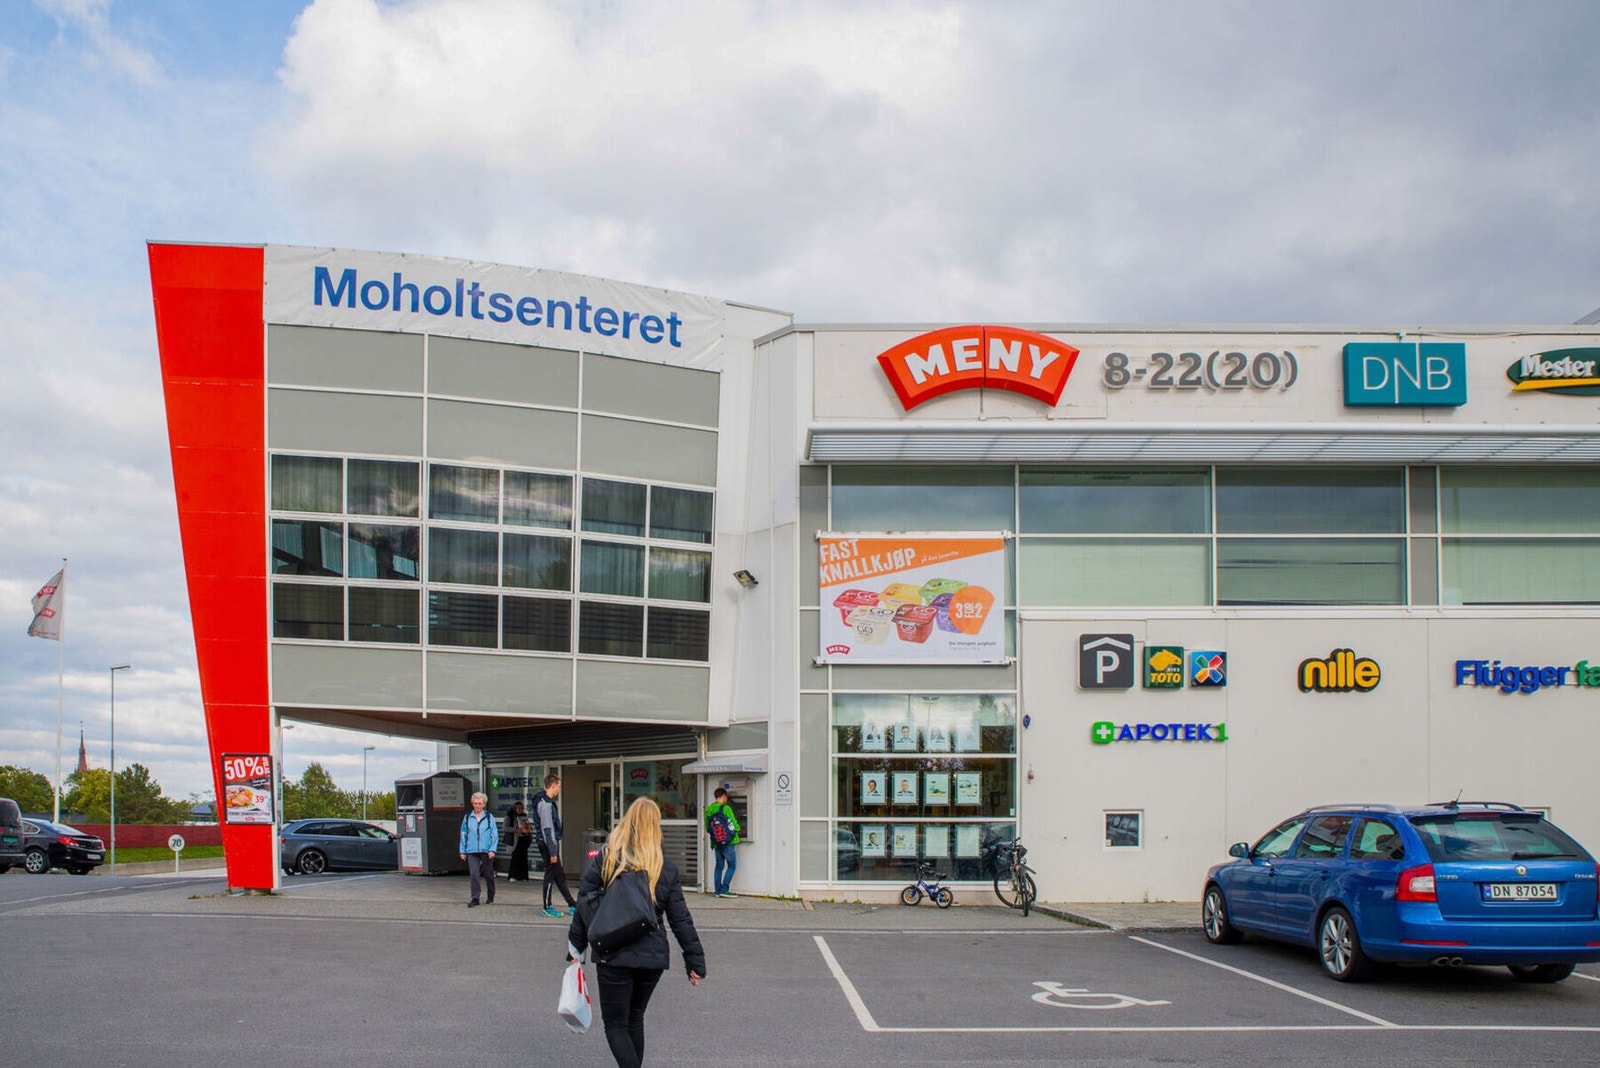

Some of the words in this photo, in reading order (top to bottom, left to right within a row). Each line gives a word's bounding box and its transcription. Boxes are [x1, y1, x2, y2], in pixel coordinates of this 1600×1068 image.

[314, 266, 682, 348] Moholtsenteret
[904, 338, 1060, 384] MENY
[1104, 350, 1299, 392] 8-22(20)
[1362, 343, 1452, 404] DNB
[1520, 354, 1596, 378] Mester
[820, 538, 859, 563] FAST
[820, 547, 916, 585] KNALLKJØP
[955, 602, 964, 618] 3
[975, 602, 983, 618] 2
[1096, 650, 1120, 684] P
[1151, 672, 1182, 683] TOTO
[1304, 651, 1381, 689] nille
[1456, 660, 1571, 693] Flügger
[224, 756, 264, 780] 50%
[172, 838, 182, 847] 70
[1493, 885, 1511, 897] DN
[1516, 885, 1555, 897] 87054
